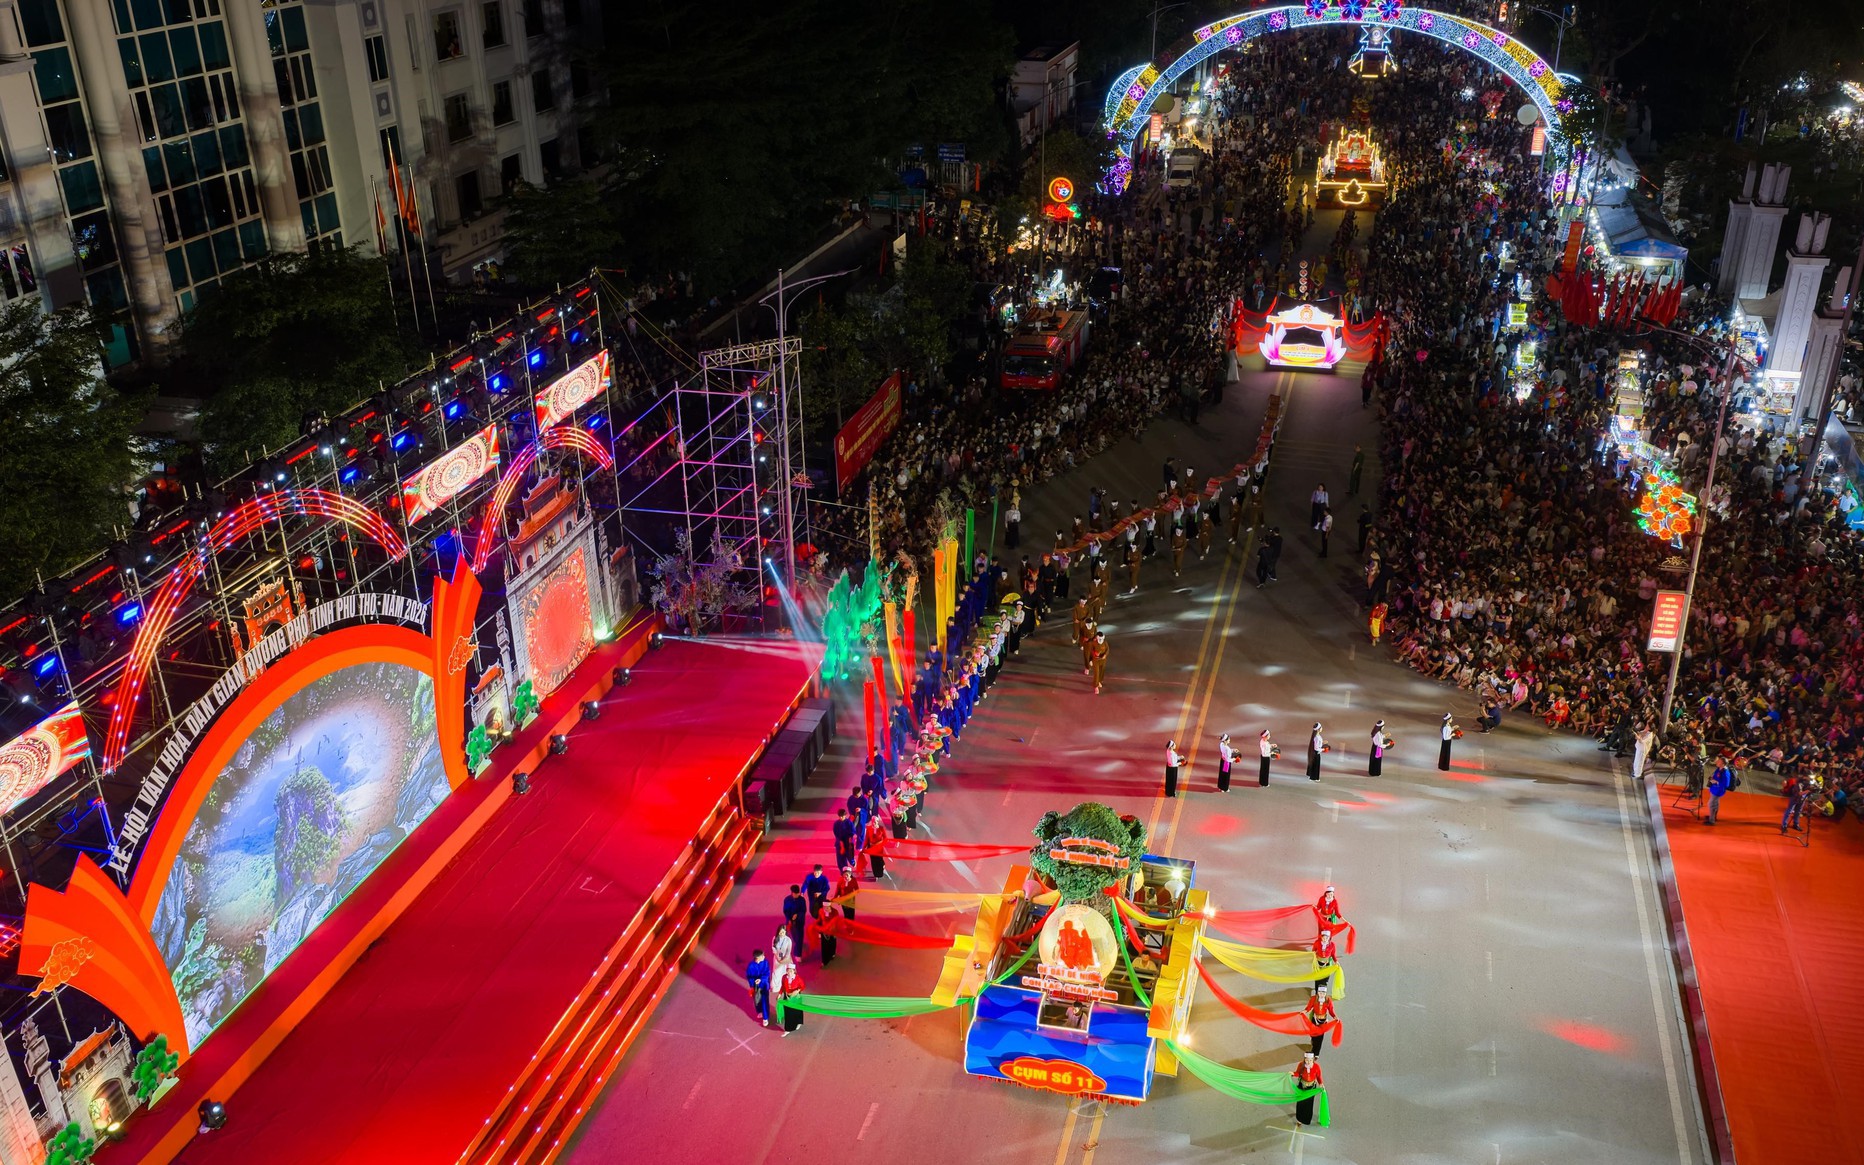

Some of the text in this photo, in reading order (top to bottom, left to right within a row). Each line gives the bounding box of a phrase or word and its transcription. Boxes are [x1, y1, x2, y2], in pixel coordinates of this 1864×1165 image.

[107, 843, 132, 875] LỄ
[121, 808, 149, 844] HỘI
[140, 764, 168, 809] VĂN
[161, 731, 191, 772] HÓA
[186, 695, 216, 737] DÂN
[212, 661, 245, 706] GIAN
[286, 604, 309, 646] PHỐ
[310, 598, 334, 631] TỈNH
[336, 590, 356, 621] PHÚ
[359, 593, 377, 621] THỌ
[382, 589, 405, 618] NĂM
[404, 598, 428, 626] 2026
[1013, 1065, 1093, 1089] CỤM SỐ 11
